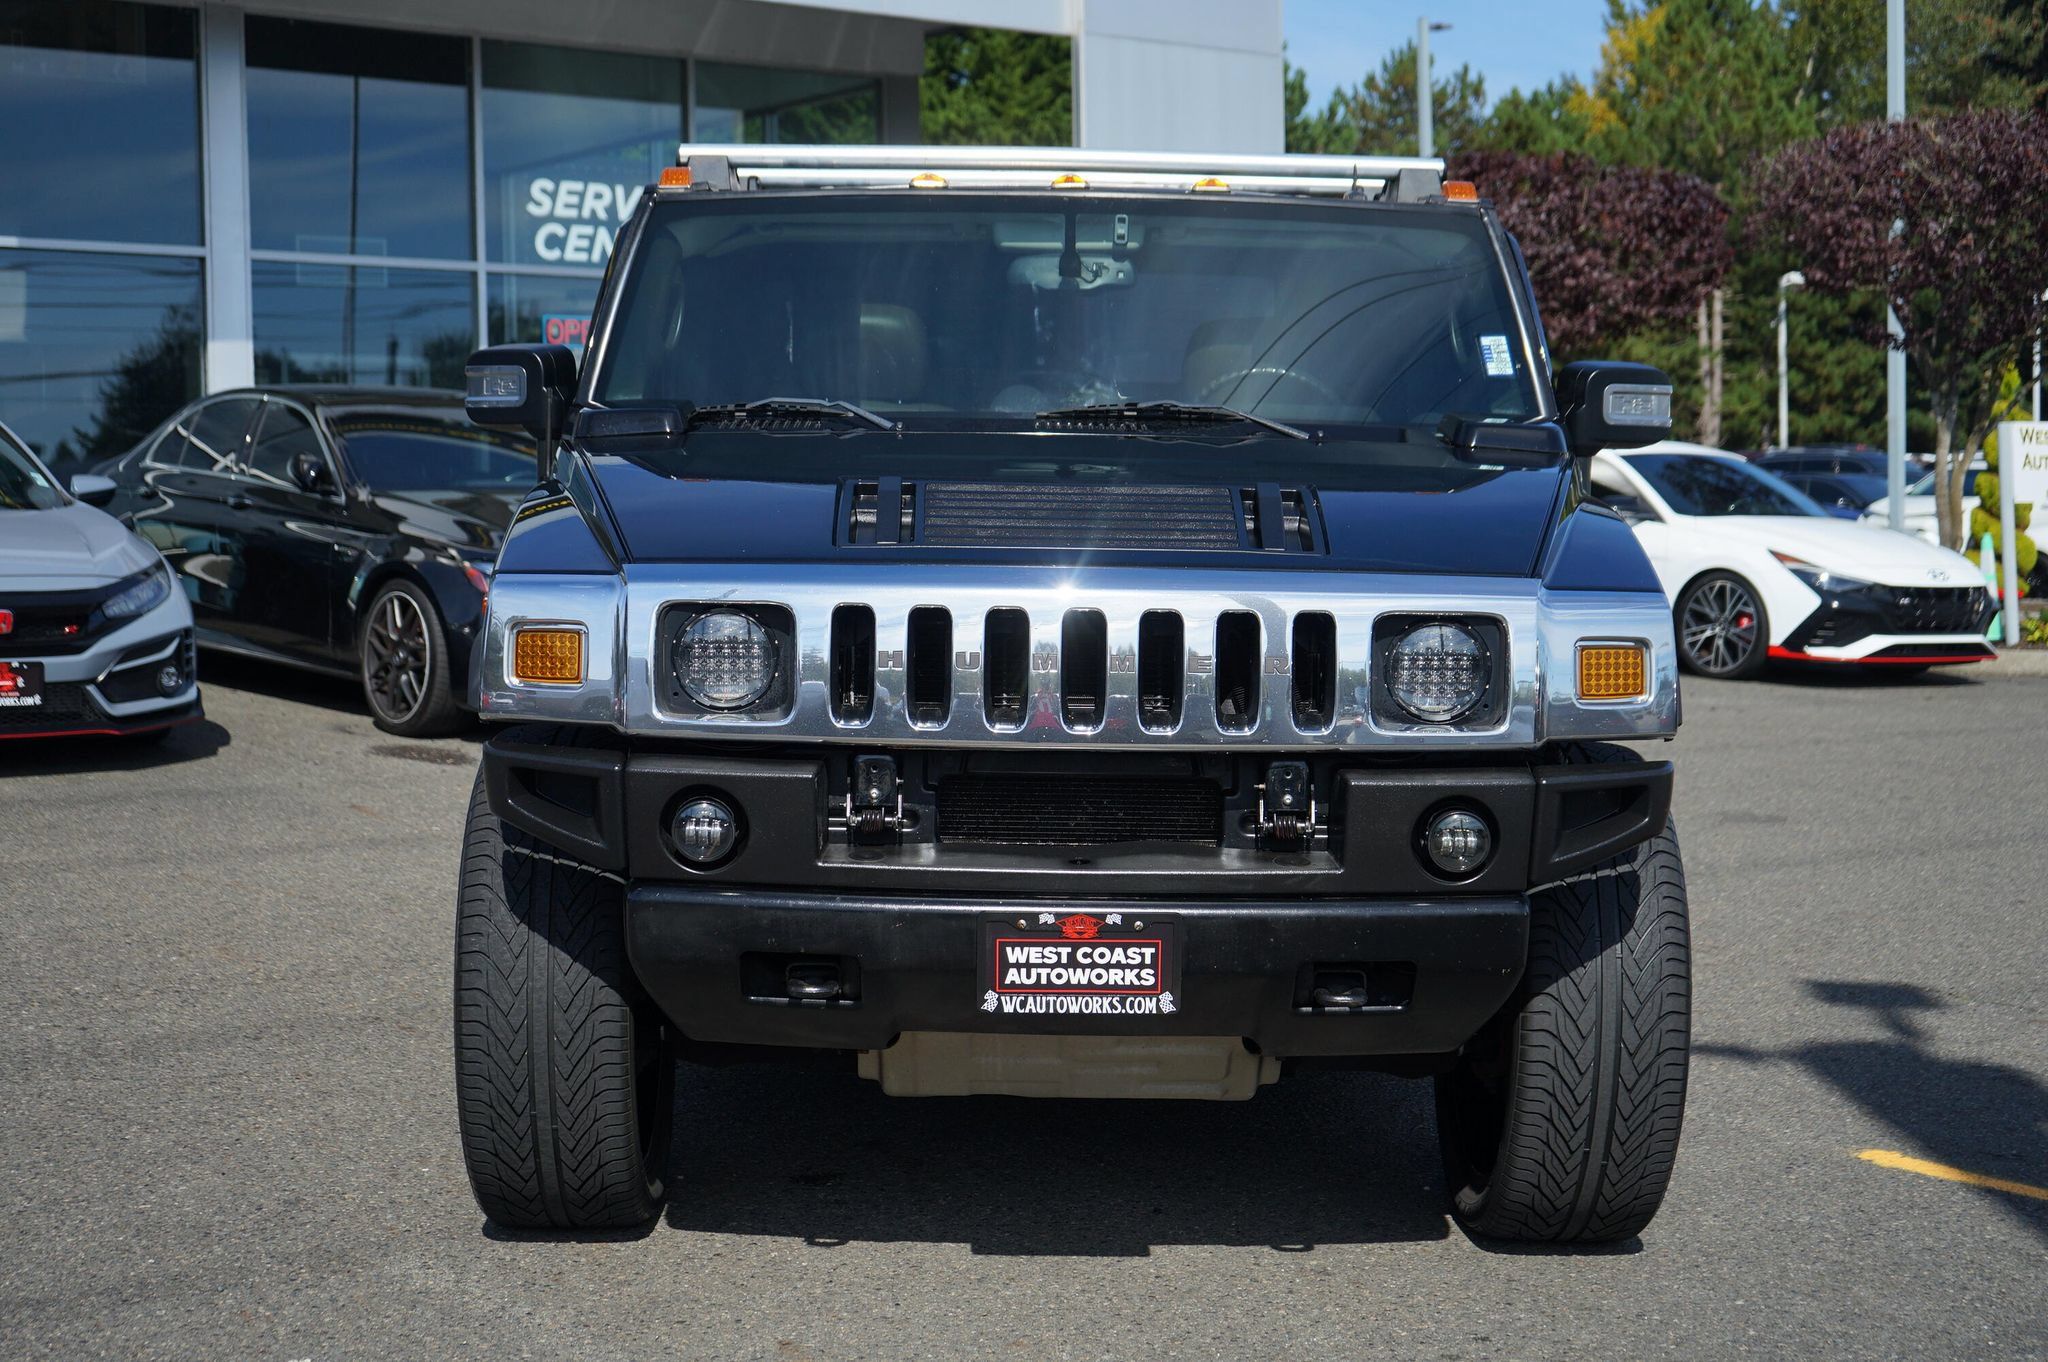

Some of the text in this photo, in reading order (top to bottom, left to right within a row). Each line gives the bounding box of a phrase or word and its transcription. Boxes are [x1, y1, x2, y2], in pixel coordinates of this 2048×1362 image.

[878, 650, 1290, 675] HUMMER
[1006, 946, 1155, 964] WEST COAST
[1004, 968, 1155, 986] AUTOWORKS
[1001, 996, 1157, 1014] WCAUTOWORKS.COM
